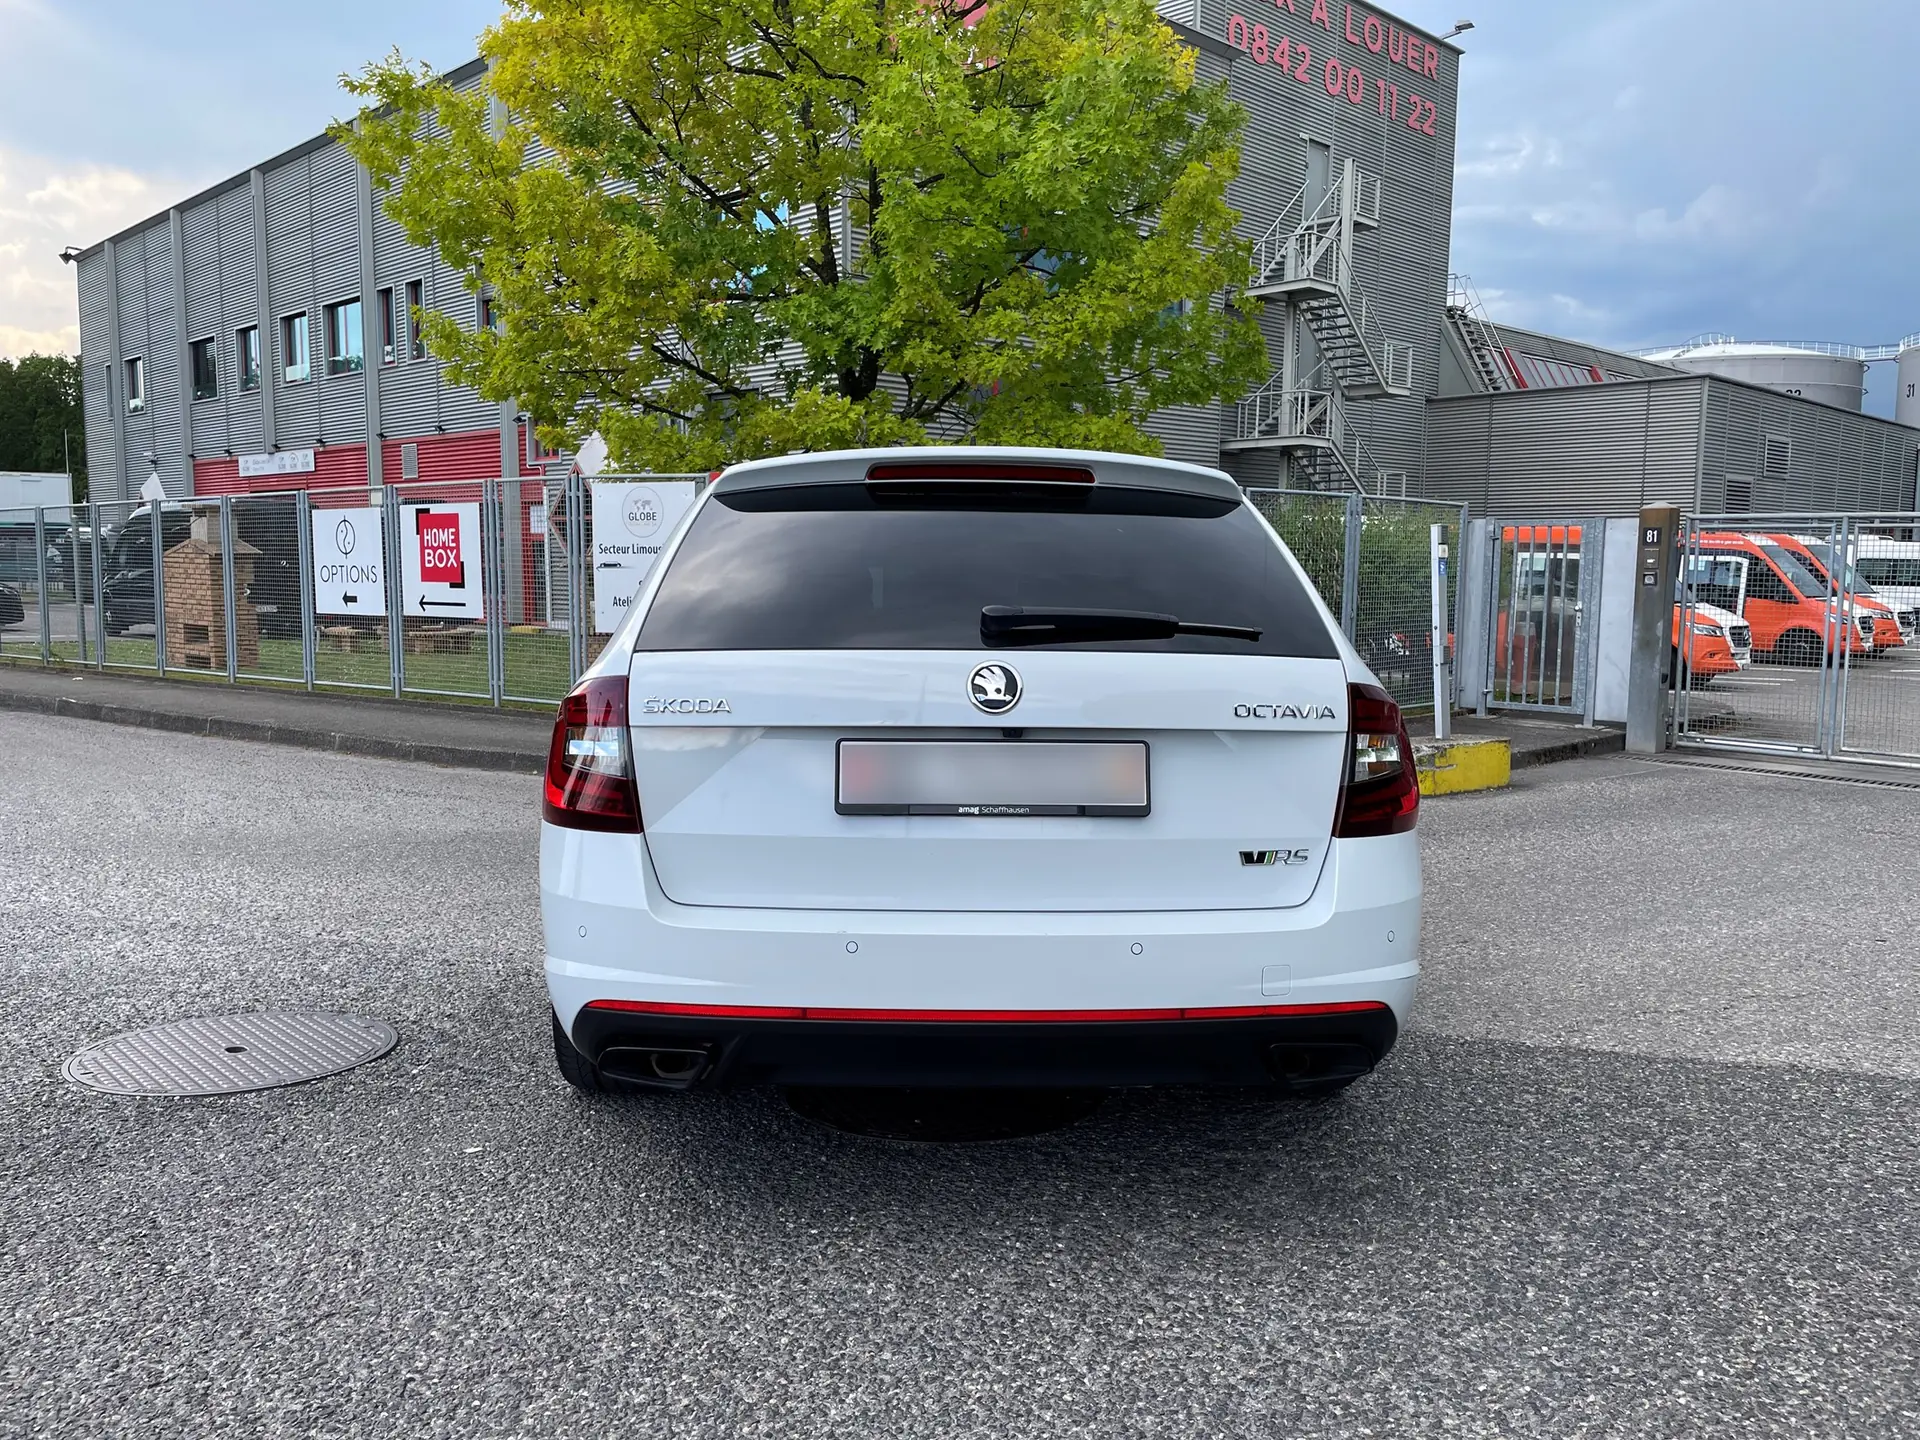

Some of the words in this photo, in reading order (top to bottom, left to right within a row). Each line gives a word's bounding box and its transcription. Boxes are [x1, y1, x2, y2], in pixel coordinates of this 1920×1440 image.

[1345, 4, 1438, 80] LOUER
[1228, 13, 1311, 84] 0842
[1324, 57, 1363, 104] 00
[1376, 79, 1397, 121] 11
[1407, 94, 1436, 137] 22
[1907, 383, 1916, 398] 31
[628, 511, 658, 521] GLOBE
[424, 528, 456, 547] HOME
[1646, 530, 1658, 542] 81
[599, 543, 630, 554] Secteur
[424, 549, 458, 568] BOX
[320, 565, 378, 583] OPTIONS
[643, 695, 732, 714] ŠKODA
[1234, 703, 1336, 720] OCTAVIA
[958, 806, 980, 815] amag
[981, 806, 1030, 814] Schaffhausen
